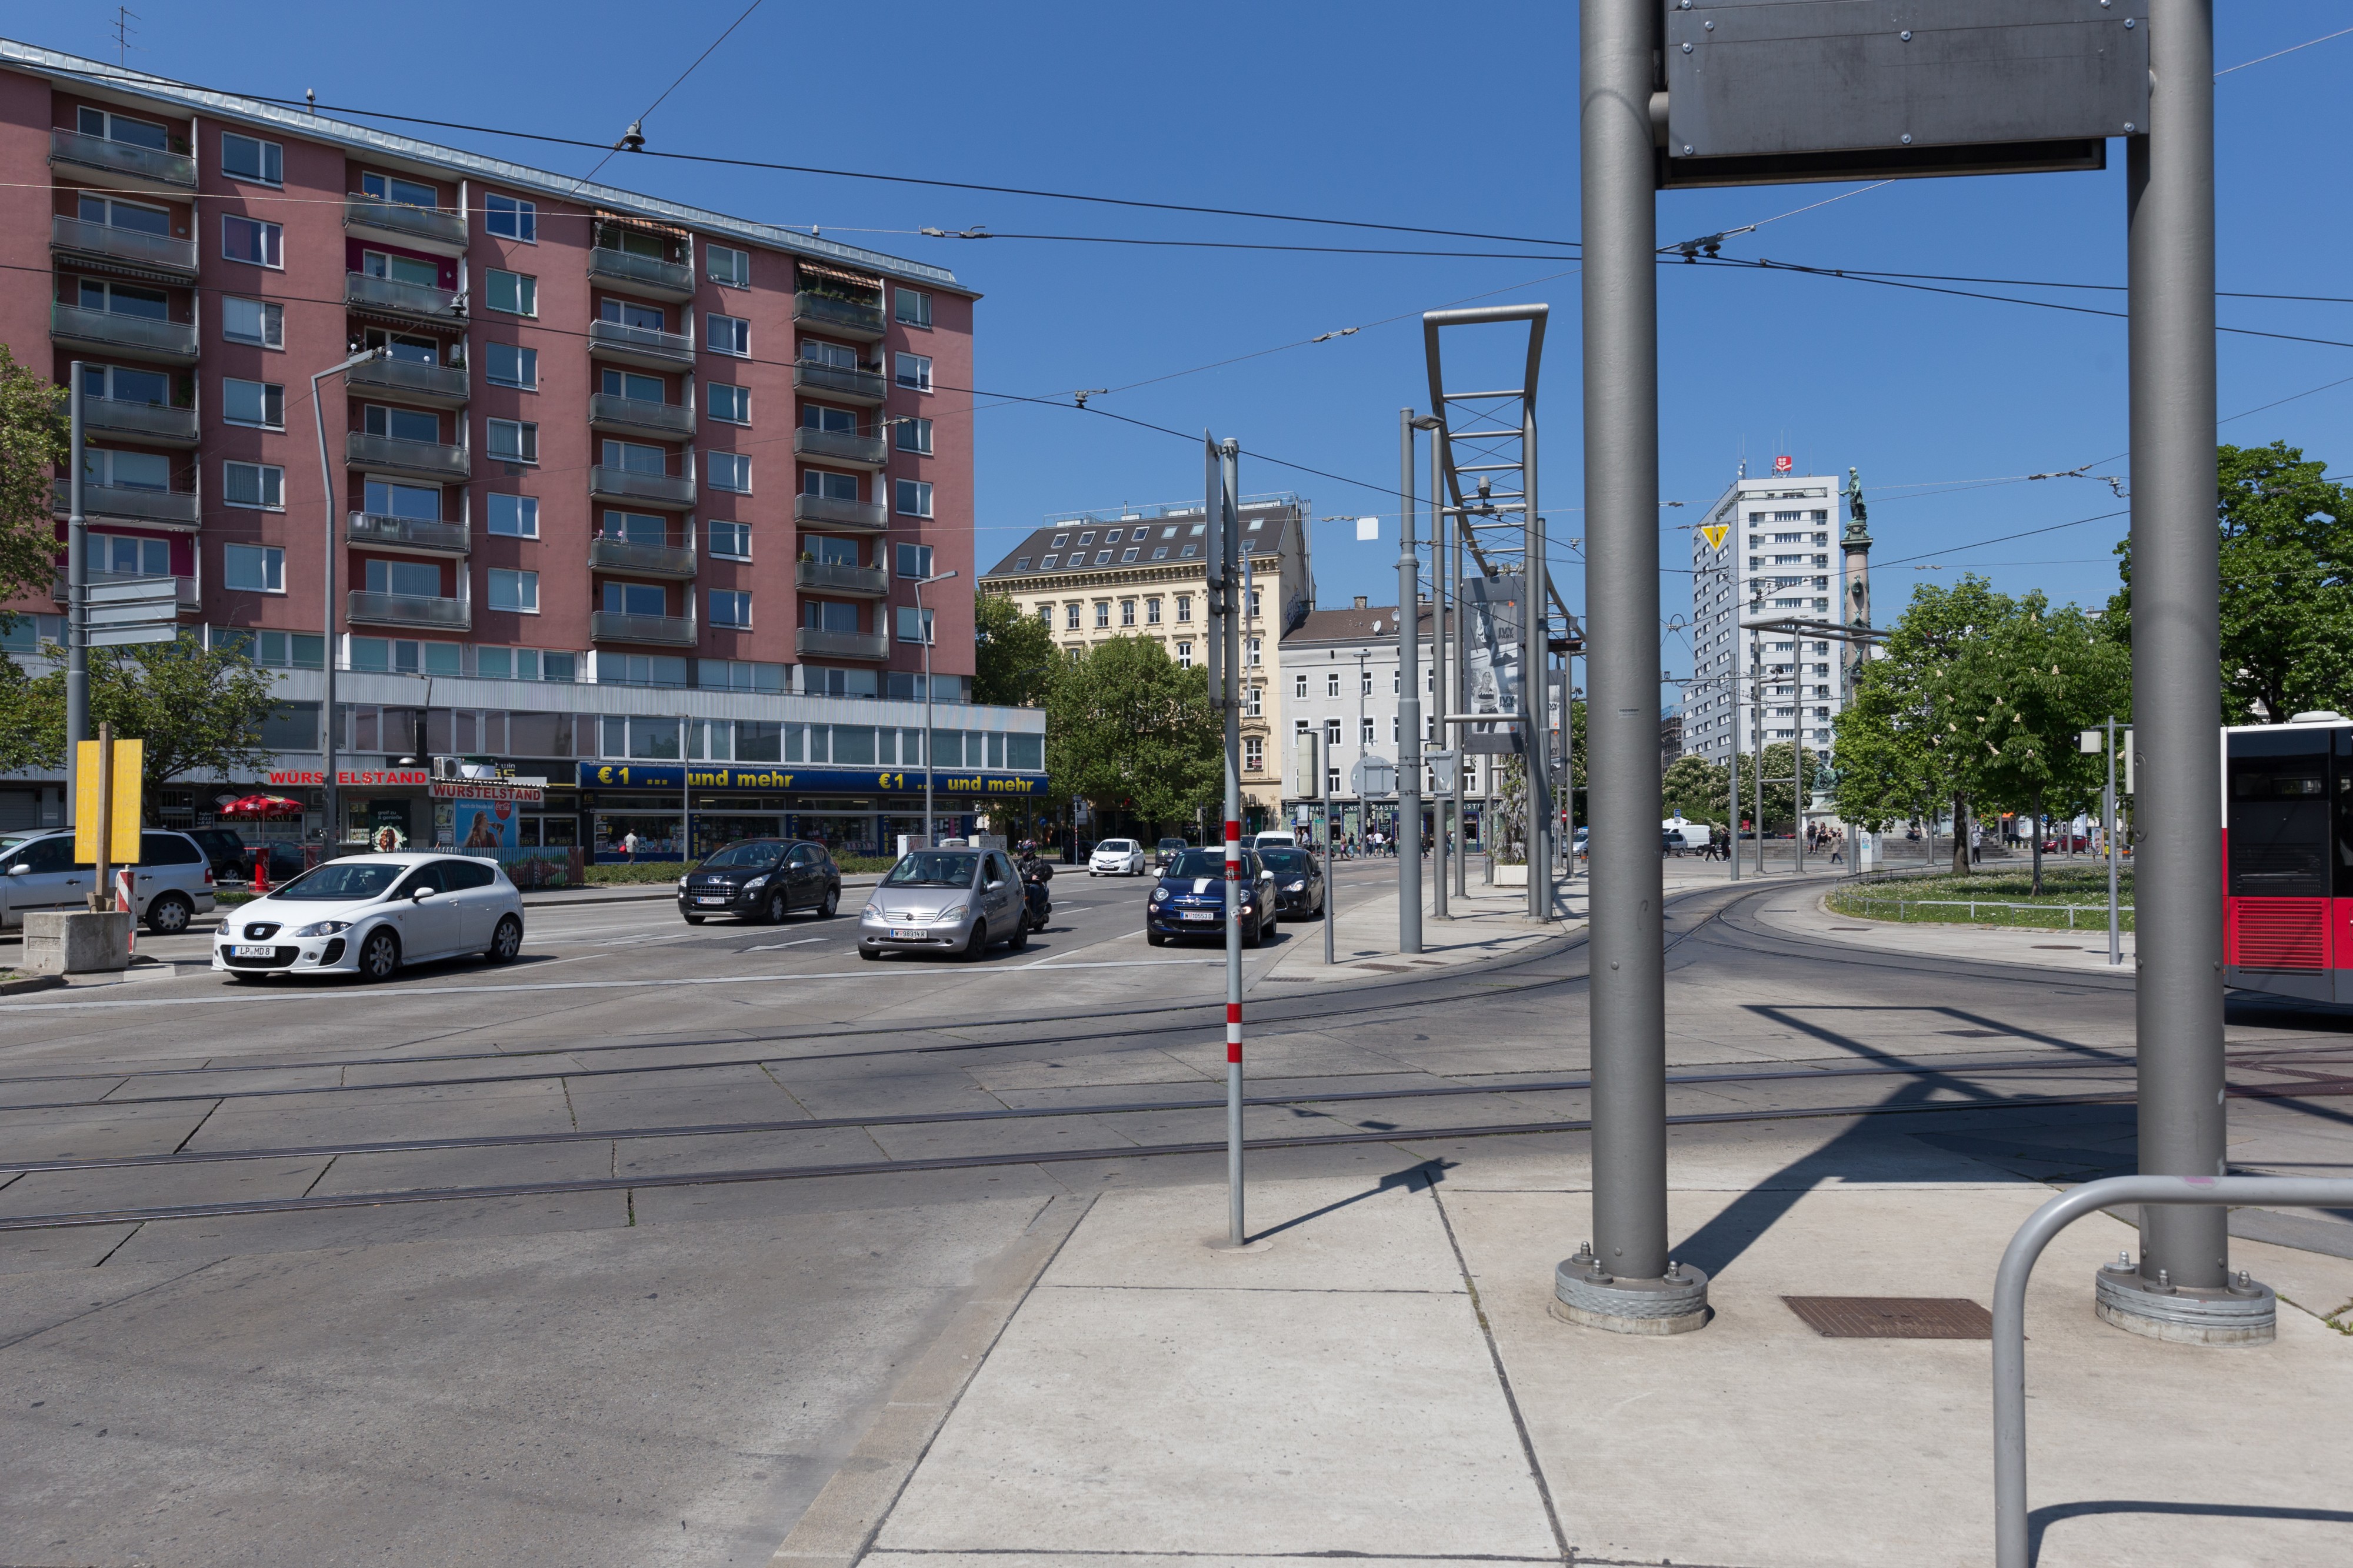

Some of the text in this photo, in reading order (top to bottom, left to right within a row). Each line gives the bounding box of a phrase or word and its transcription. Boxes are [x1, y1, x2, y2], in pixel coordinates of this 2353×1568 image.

[269, 770, 426, 784] WÜRSELSTAND
[688, 770, 728, 786] und
[738, 771, 794, 788] mehr
[948, 776, 981, 791] und
[988, 777, 1034, 792] mehr
